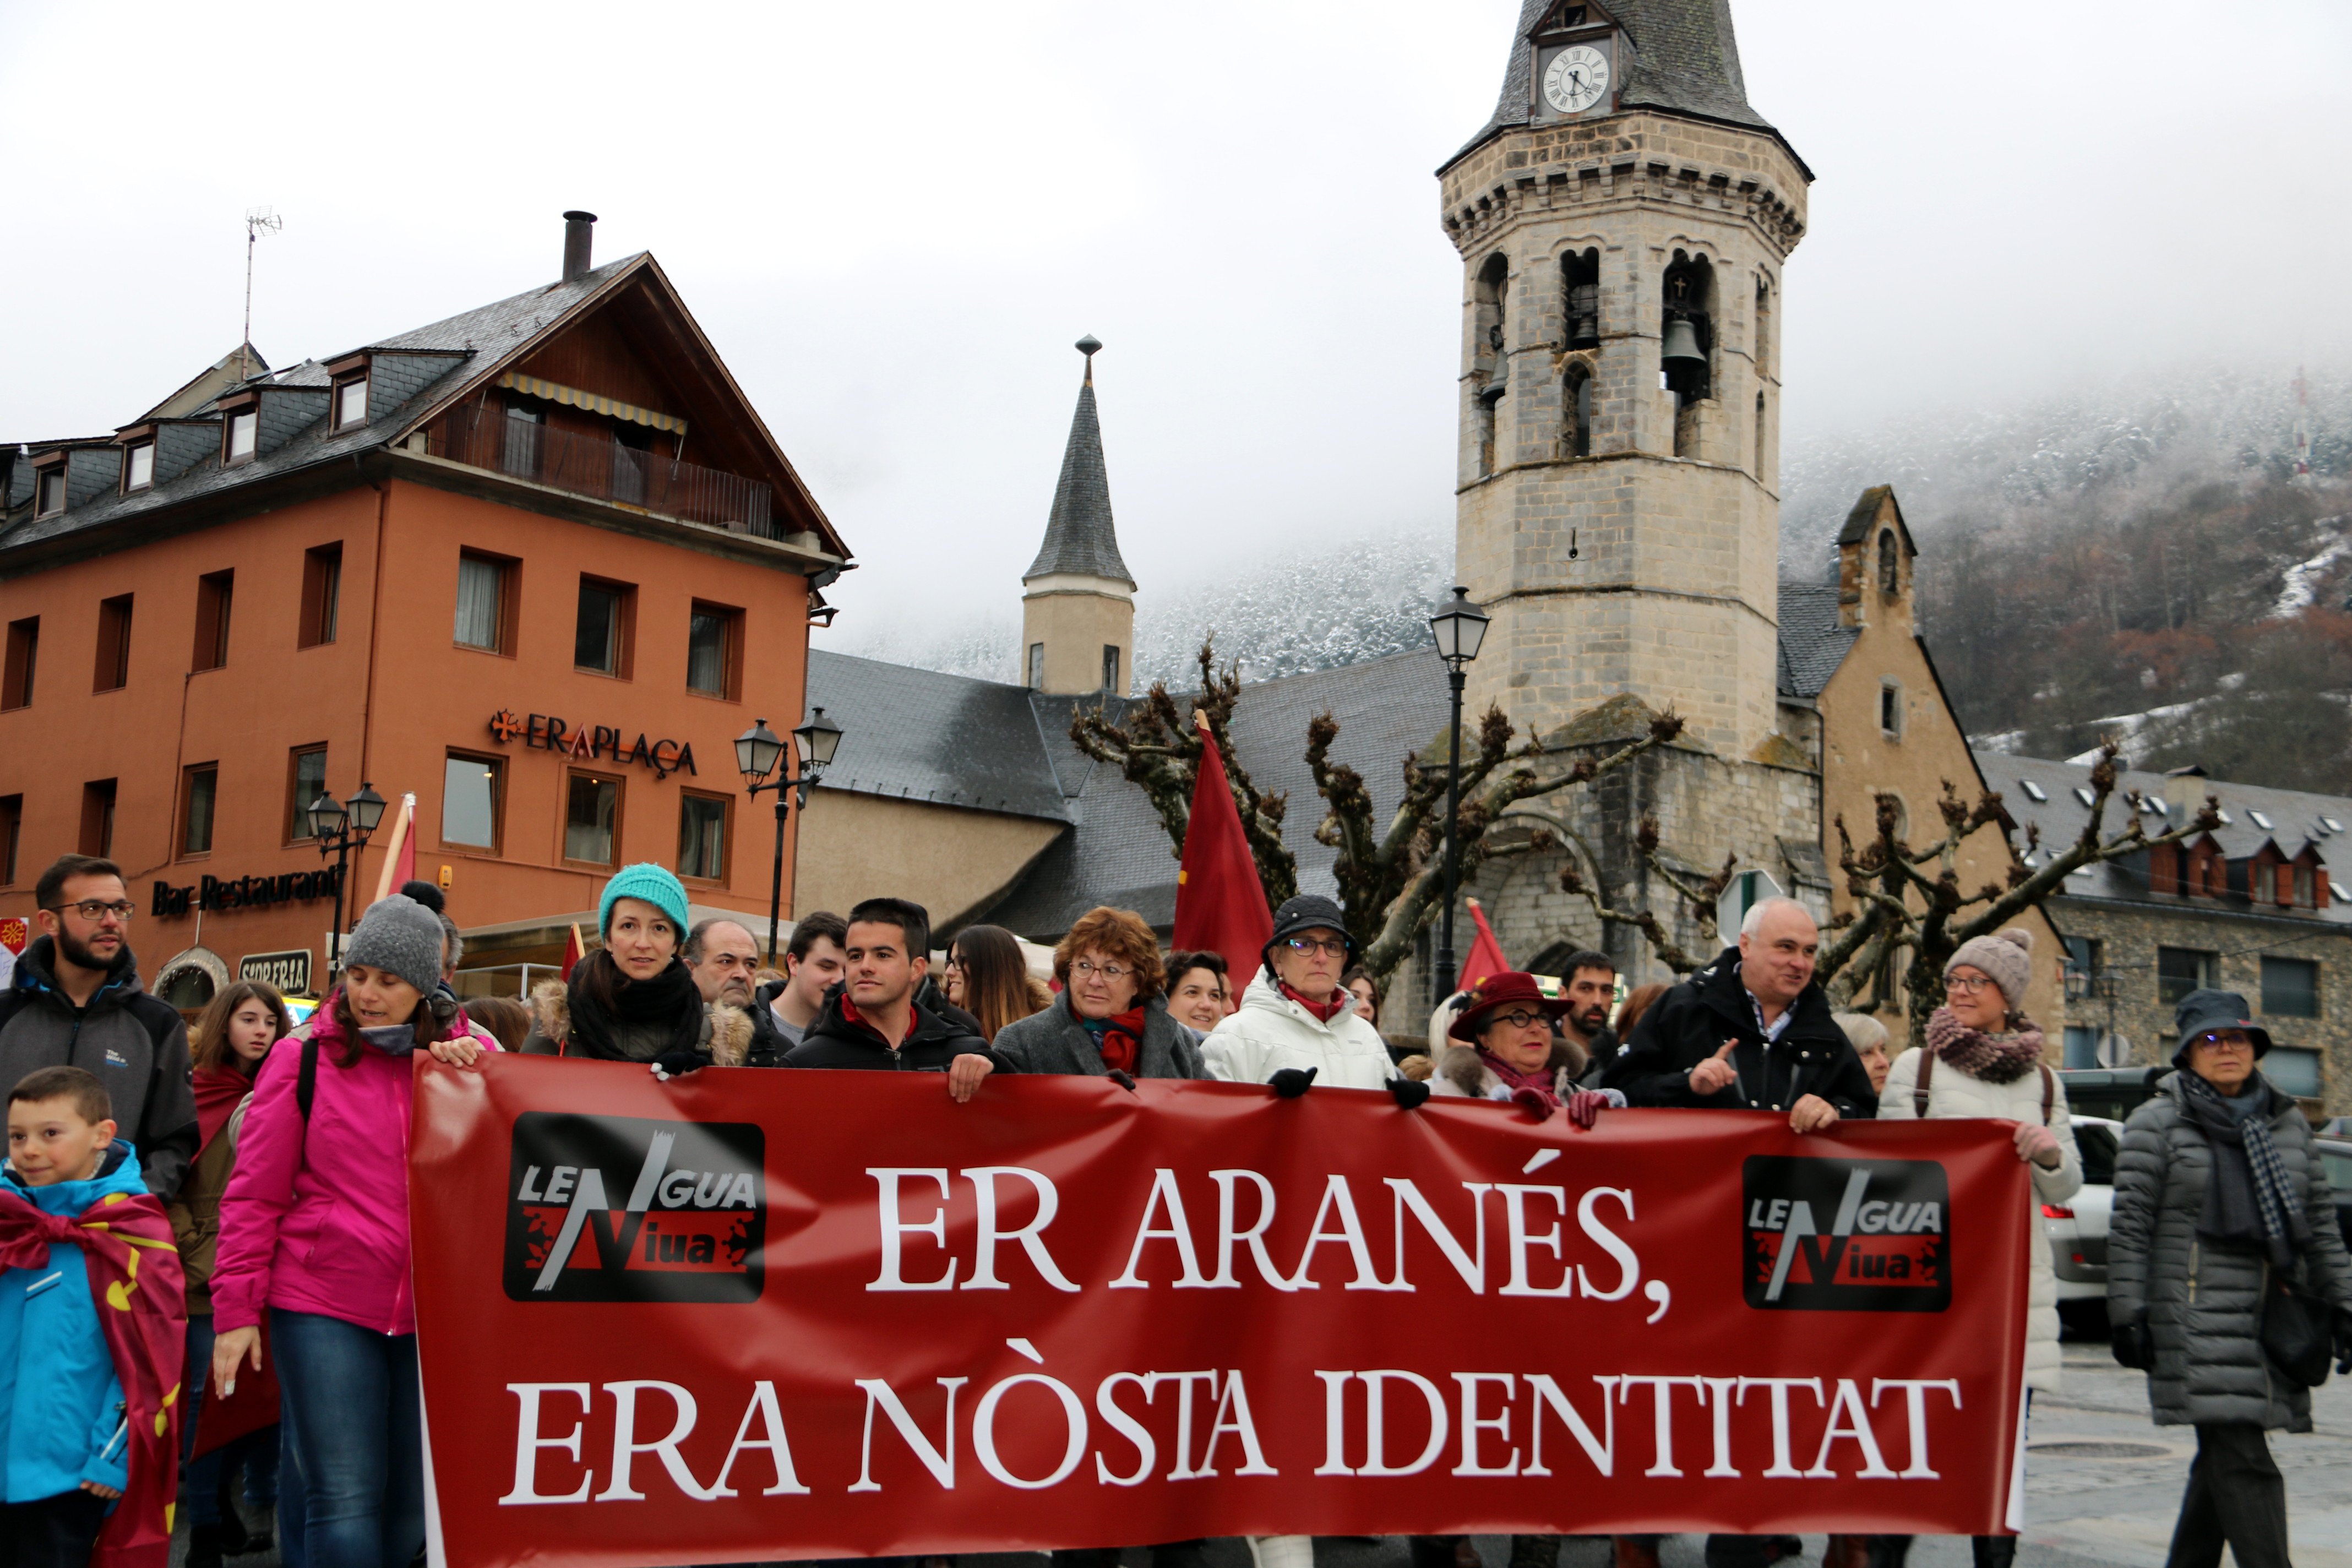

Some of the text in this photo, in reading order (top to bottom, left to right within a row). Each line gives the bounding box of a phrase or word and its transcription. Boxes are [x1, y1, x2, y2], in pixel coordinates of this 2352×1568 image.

[151, 865, 338, 916] Bar Restaurant
[518, 1129, 757, 1292] LENGUA
[865, 1148, 1670, 1324] ER ARANÉS,
[1749, 1167, 1942, 1301] LENGUA
[498, 1338, 1962, 1505] ERA NÒSTA IDENTITAT
